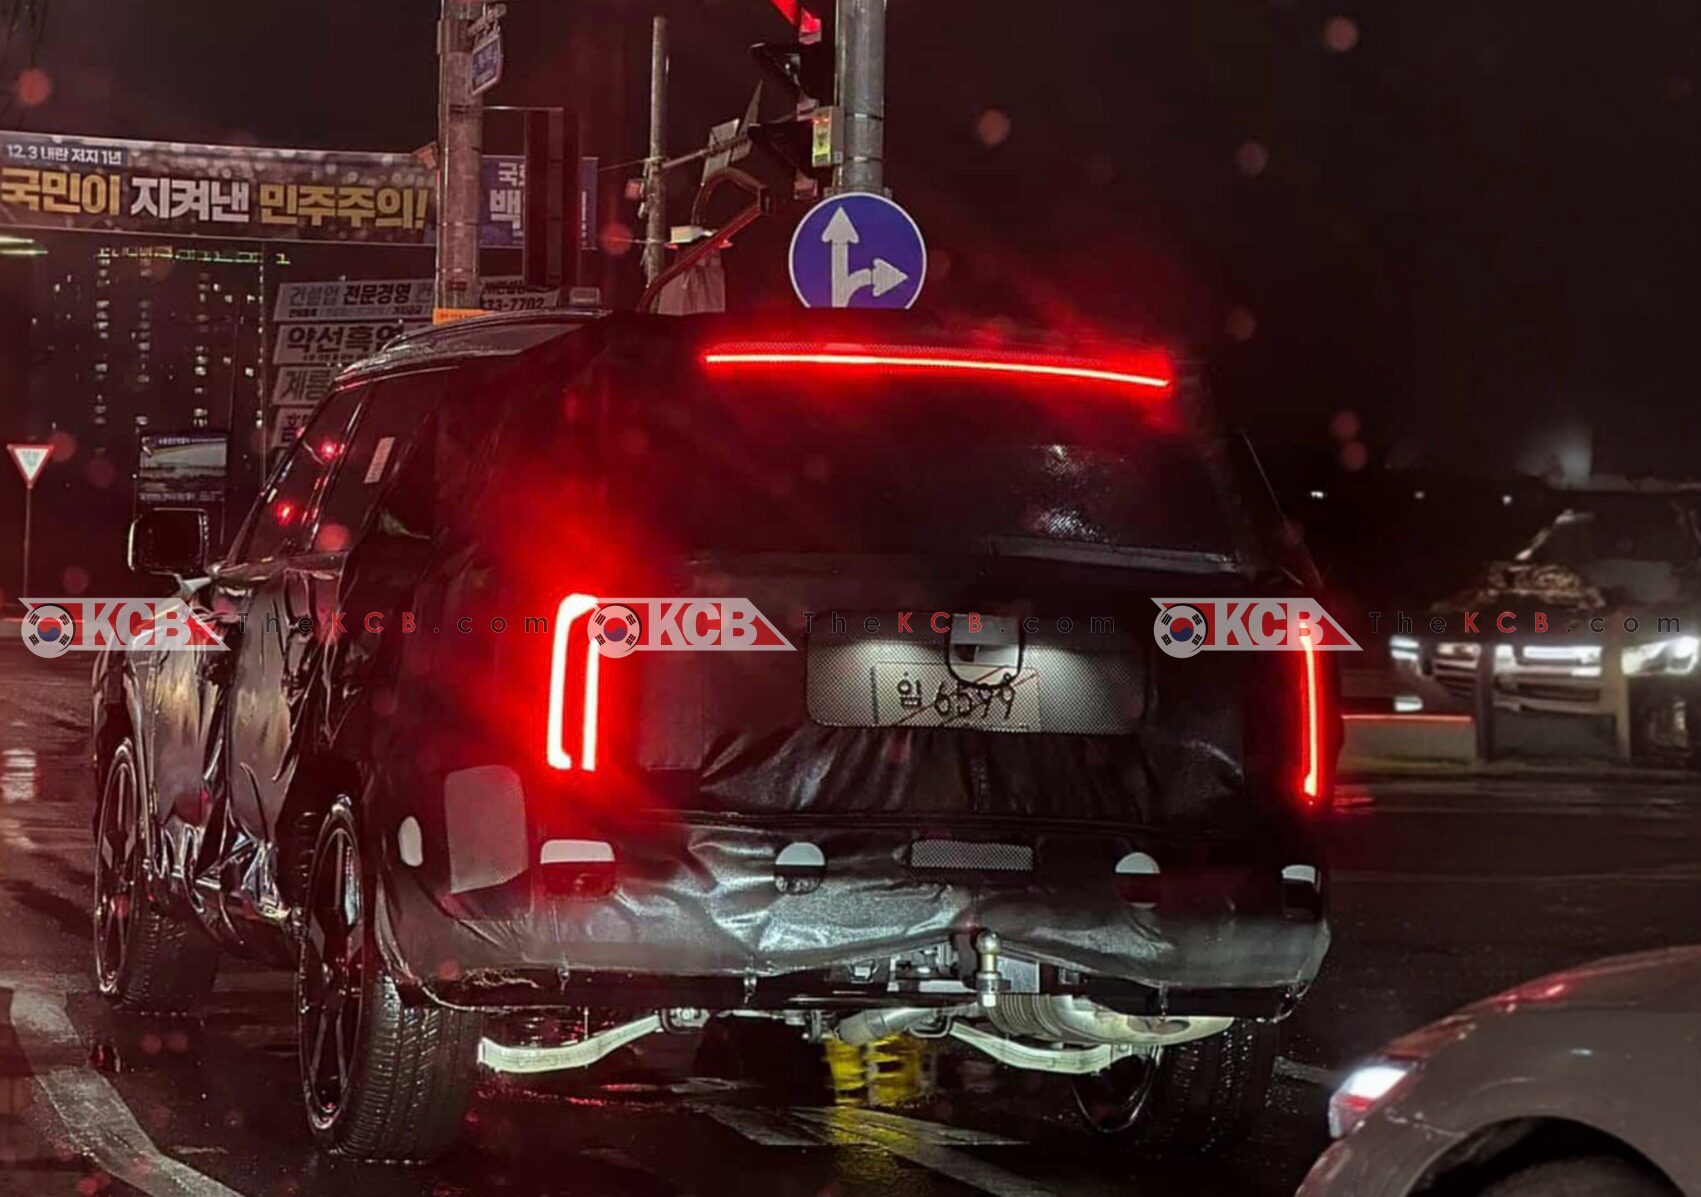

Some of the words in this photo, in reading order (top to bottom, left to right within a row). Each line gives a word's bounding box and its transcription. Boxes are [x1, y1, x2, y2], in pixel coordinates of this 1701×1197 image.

[40, 146, 69, 162] 내란
[71, 148, 98, 164] 저지
[101, 150, 122, 165] 1년
[1, 167, 120, 216] 국민이
[131, 177, 249, 223] 지켜낸
[259, 183, 428, 229] 민주주의!
[344, 283, 411, 306] 전문경영
